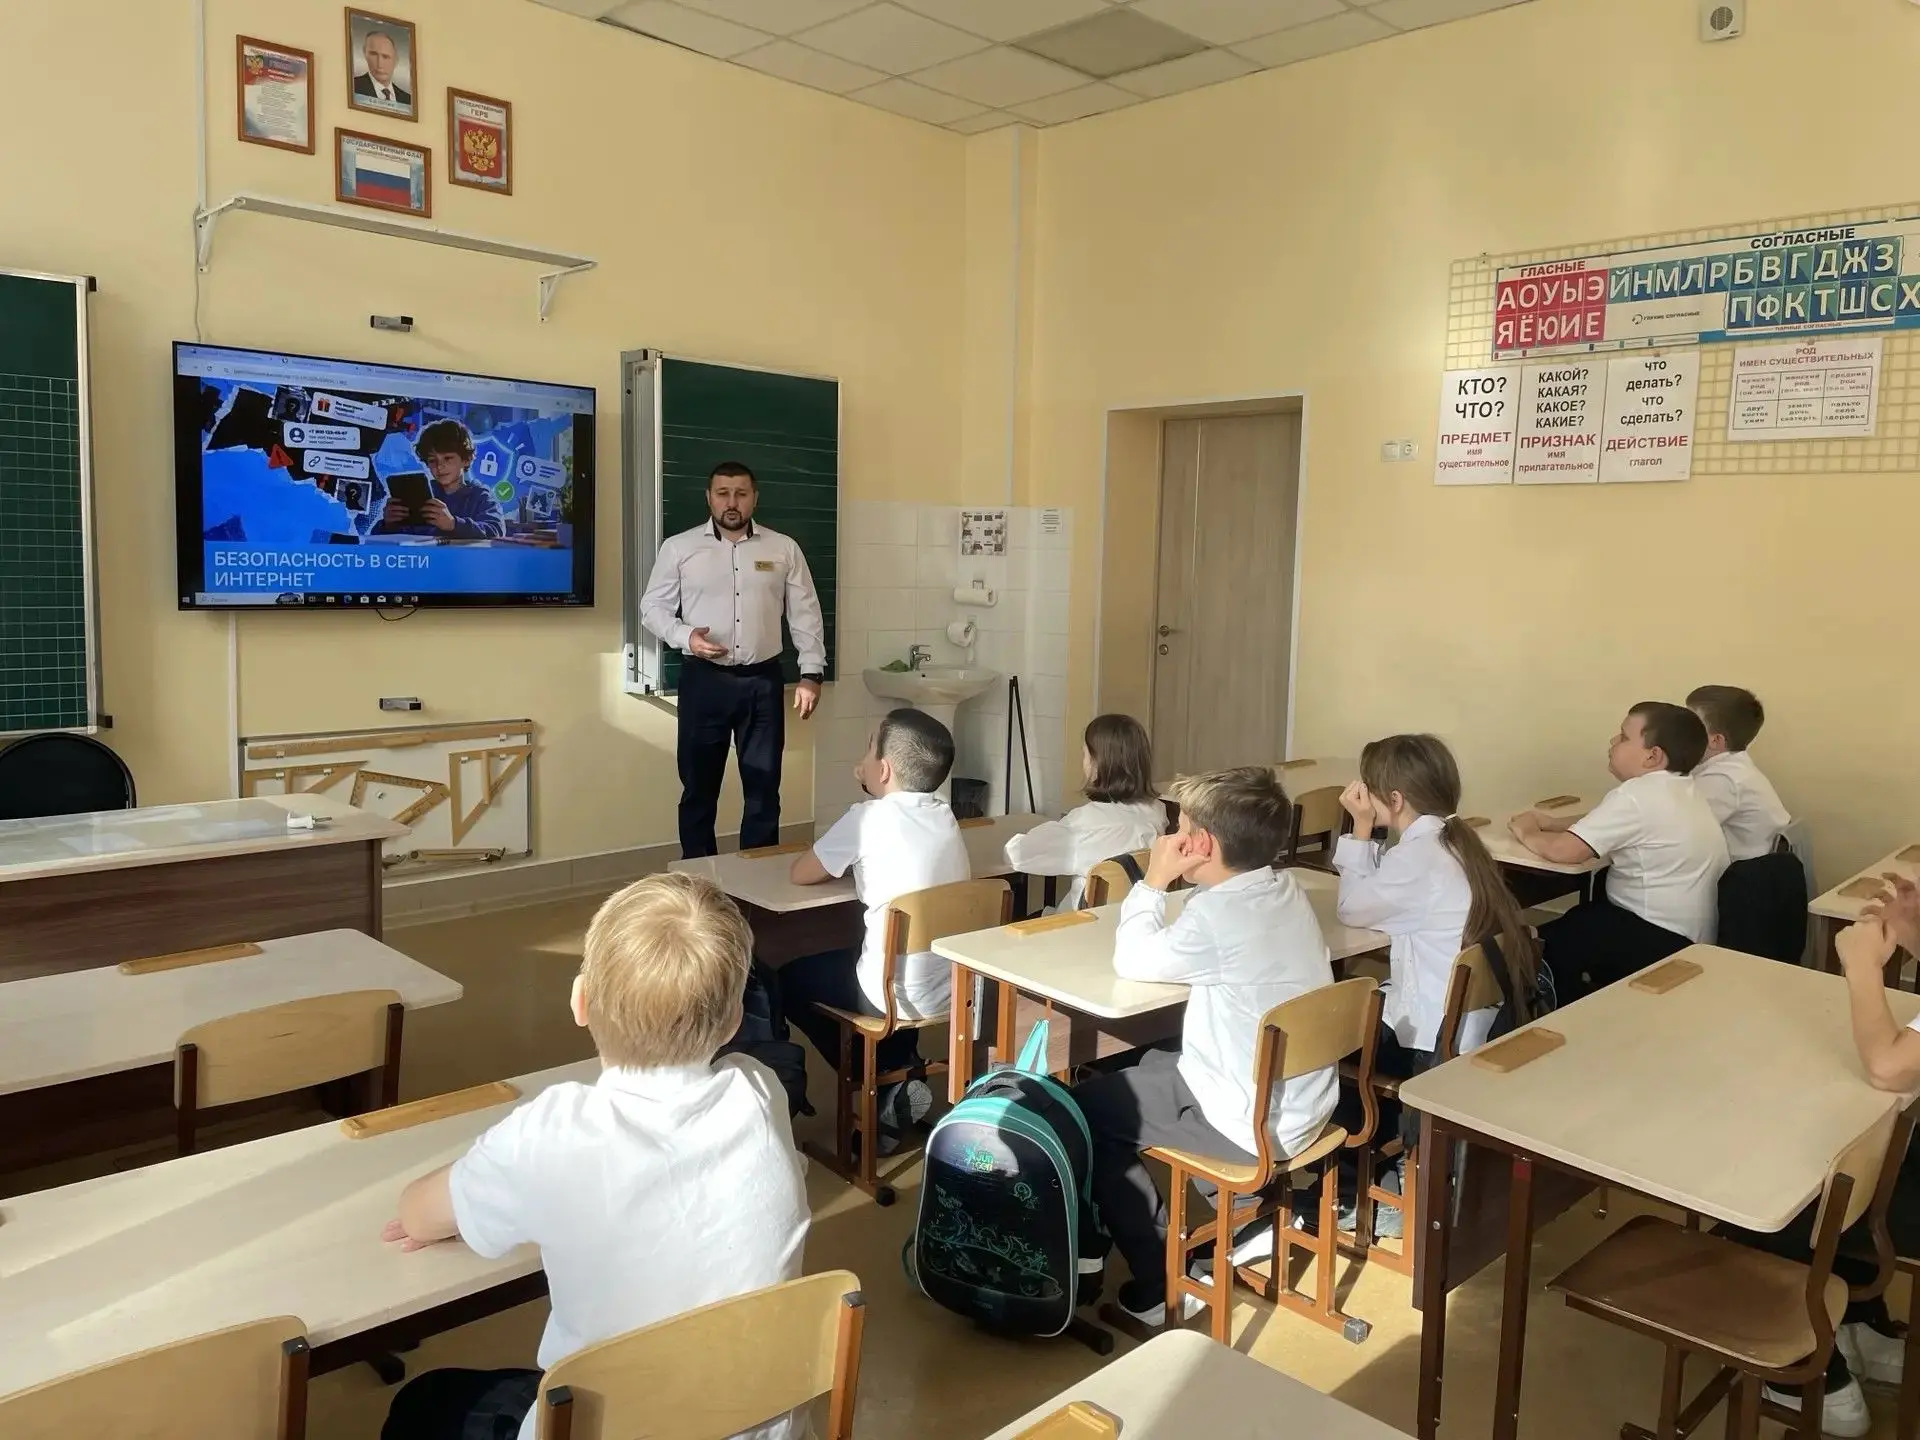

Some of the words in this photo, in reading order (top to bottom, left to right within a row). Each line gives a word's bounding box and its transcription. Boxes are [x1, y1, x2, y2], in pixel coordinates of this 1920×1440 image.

[1750, 228, 1855, 249] СОГЛАСНЫЕ
[1520, 260, 1586, 278] ГЛАСНЫЕ
[1795, 347, 1817, 355] РОД
[1645, 361, 1667, 371] что
[1768, 352, 1874, 367] СУЩЕСТВИТЕЛЬНЫХ
[1538, 368, 1589, 384] КАКОЙ?
[1625, 374, 1682, 392] делать?
[1458, 376, 1507, 396] КТО?
[1537, 385, 1587, 398] КАКАЯ?
[1536, 400, 1586, 413] КАКОЕ?
[1642, 396, 1664, 406] что
[1455, 401, 1505, 419] ЧТО?
[1620, 409, 1683, 426] сделать?
[1535, 415, 1585, 429] КАКИЕ?
[1440, 431, 1512, 445] ПРЕДМЕТ
[1520, 433, 1597, 449] ПРИЗНАК
[1606, 435, 1689, 452] ДЕЙСТВИЕ
[1547, 451, 1566, 459] имя
[1629, 458, 1662, 467] глагол
[1438, 459, 1510, 470] существительное
[1518, 462, 1594, 473] прилагательное
[214, 551, 365, 568] БЕЗОПАСНОСТЬ
[370, 555, 381, 568] В
[385, 554, 430, 569] СЕТИ
[214, 572, 315, 587] ИНТЕРНЕТ
